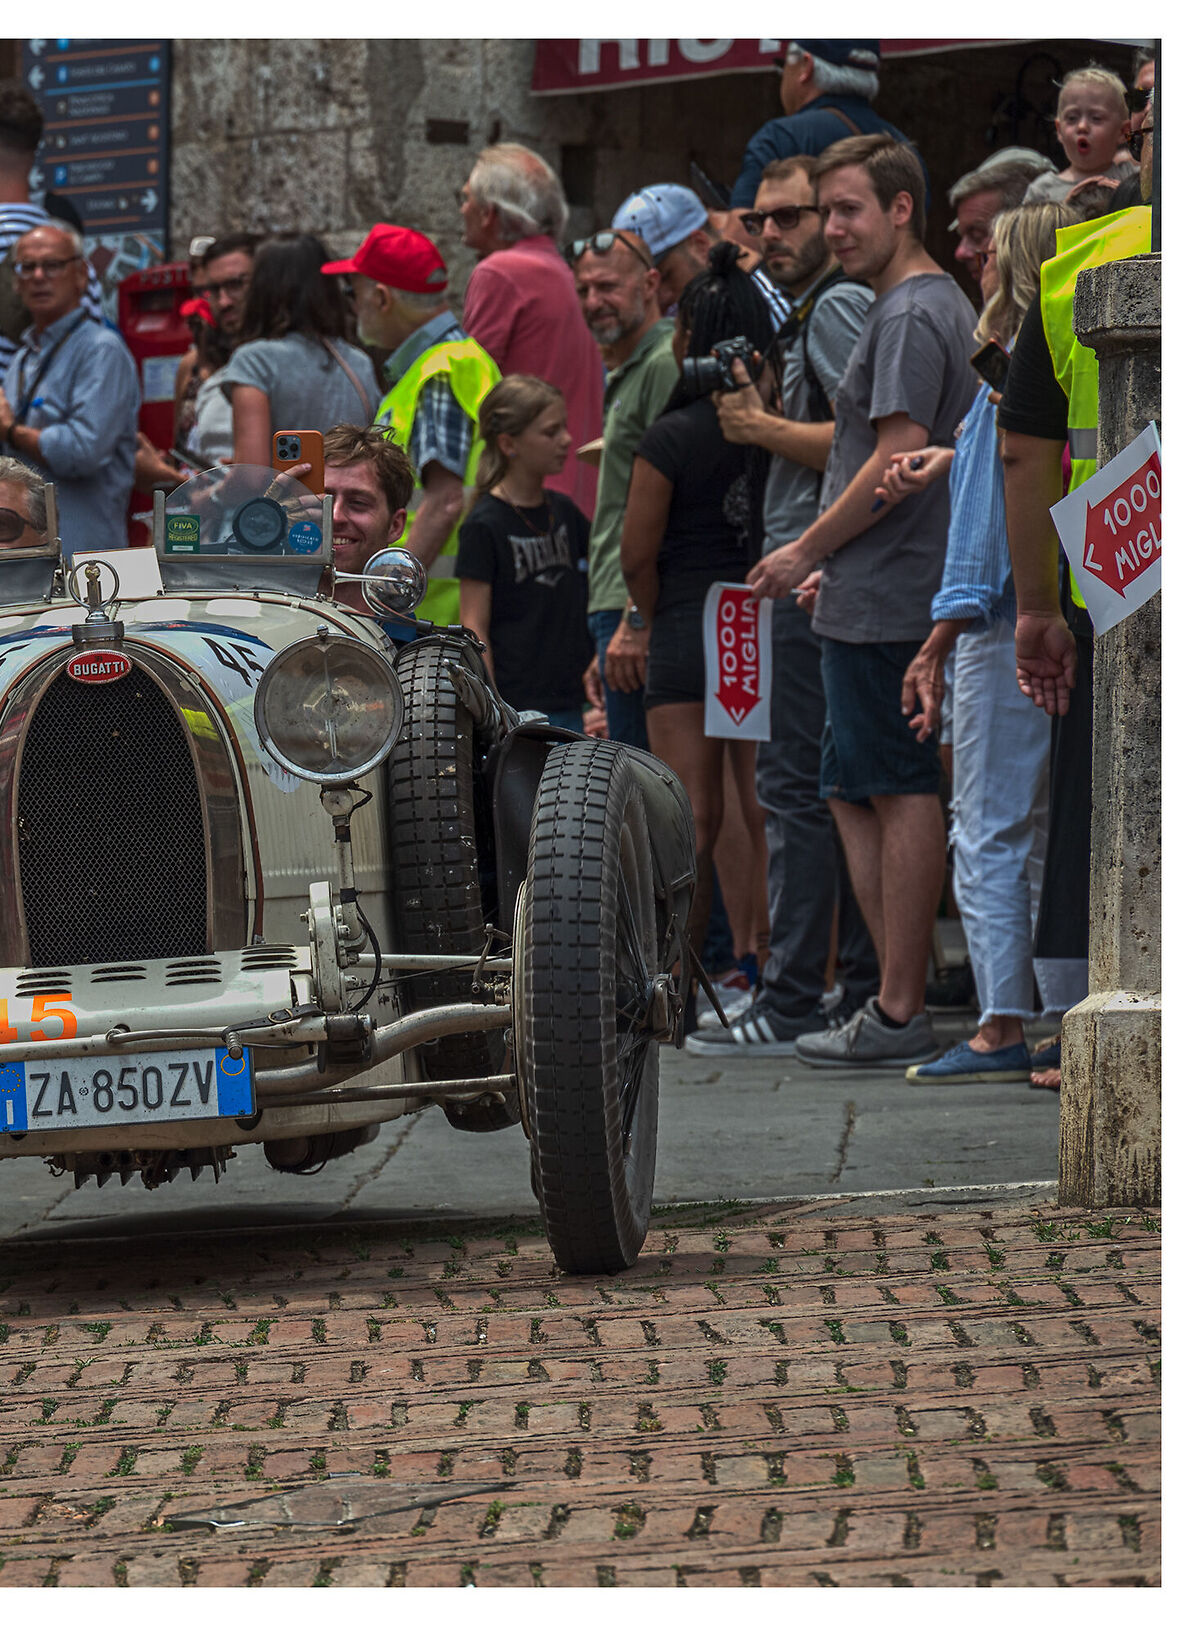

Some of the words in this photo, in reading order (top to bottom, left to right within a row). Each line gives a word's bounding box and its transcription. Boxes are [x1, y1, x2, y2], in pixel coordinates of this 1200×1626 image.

[1104, 469, 1160, 535] 1000
[1115, 520, 1161, 580] MIGL
[73, 661, 125, 676] BUGATTI
[201, 636, 265, 689] 45
[721, 601, 737, 687] 1000
[741, 597, 757, 695] MIGLIA
